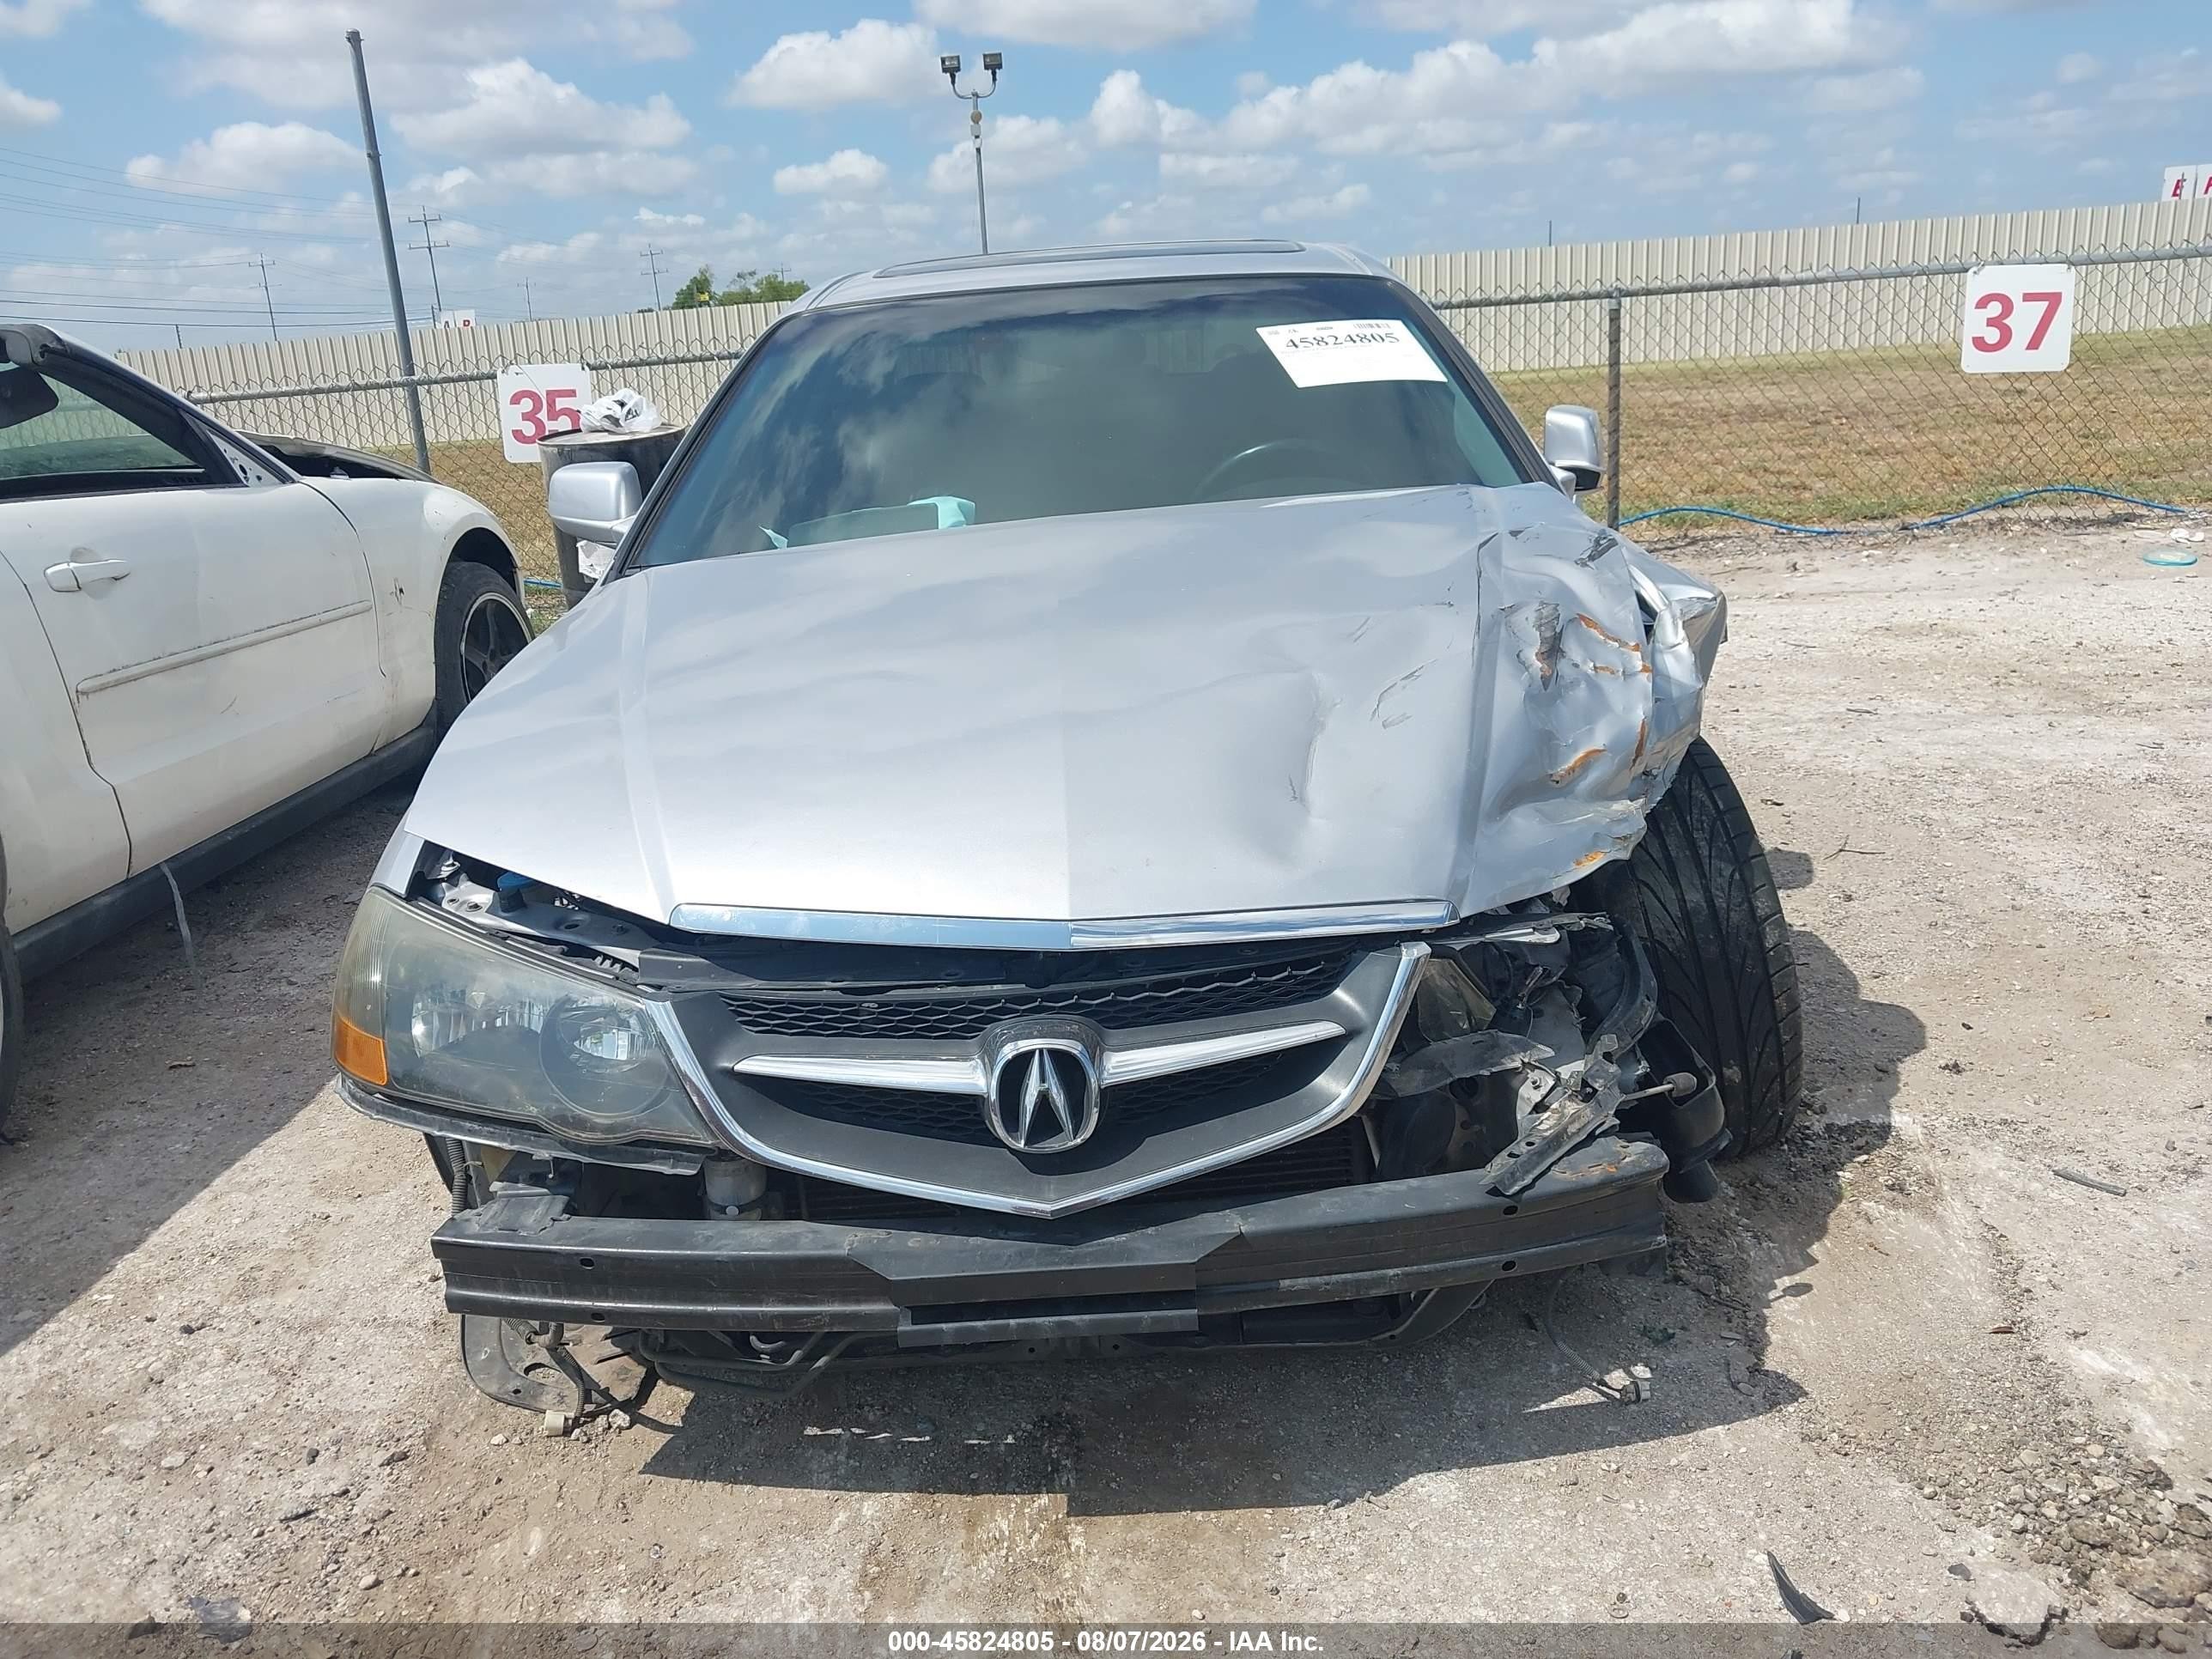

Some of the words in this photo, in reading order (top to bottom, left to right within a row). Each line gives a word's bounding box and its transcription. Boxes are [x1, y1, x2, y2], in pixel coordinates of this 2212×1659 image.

[1285, 332, 1401, 349] 45824805
[1971, 291, 2063, 354] 37
[509, 388, 581, 445] 35
